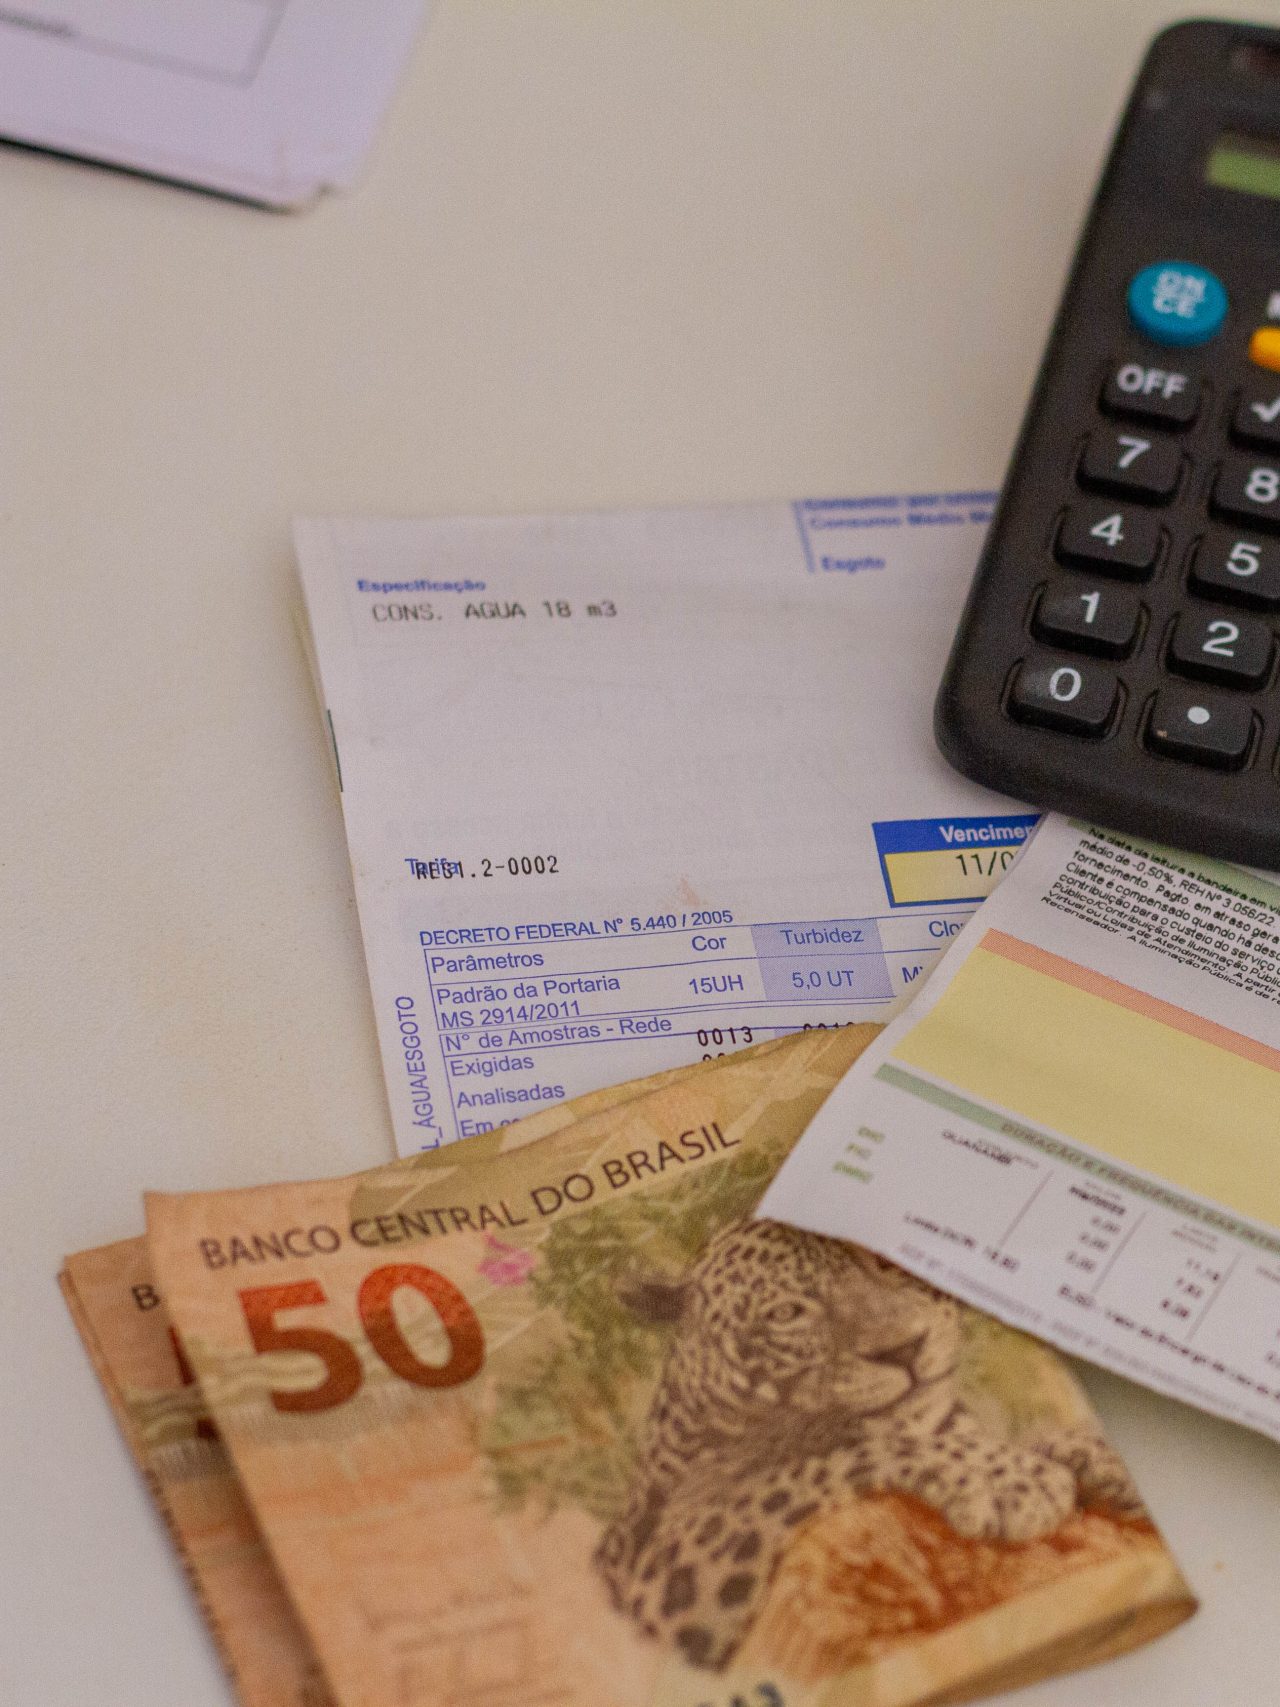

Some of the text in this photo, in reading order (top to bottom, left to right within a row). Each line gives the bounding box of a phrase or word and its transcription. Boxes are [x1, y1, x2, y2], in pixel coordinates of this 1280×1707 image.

[1117, 364, 1187, 400] OFF
[1117, 437, 1151, 469] 7
[1245, 468, 1279, 503] 8
[1091, 514, 1124, 546] 4
[1226, 544, 1260, 577] 5
[357, 579, 486, 594] Especificação
[372, 603, 442, 622] CONS.
[464, 602, 527, 619] AGUA
[543, 600, 572, 618] 18
[1080, 592, 1100, 623] 1
[1202, 622, 1239, 657] 2
[1049, 667, 1082, 702] 0
[1066, 862, 1104, 884] Cliente
[1116, 885, 1190, 920] compensado
[1192, 917, 1235, 940] quando
[420, 927, 511, 947] DECRETO
[515, 921, 600, 940] FEDERAL
[631, 914, 678, 932] 5.440
[691, 910, 733, 927] 2005
[781, 928, 865, 946] Turbidez
[929, 920, 965, 938] Clo
[1058, 874, 1130, 909] contribuição
[1131, 905, 1159, 921] para
[1170, 921, 1212, 944] custeio
[1231, 948, 1275, 971] serviço
[1213, 911, 1250, 931] atraso
[1251, 928, 1279, 944] gera
[691, 935, 728, 951] Cor
[431, 952, 545, 974] Parâmetros
[437, 975, 621, 1006] Padrão da Portaria
[689, 975, 744, 994] 15UH
[792, 970, 854, 990] 5,0 UT
[441, 1000, 582, 1029] MS 2914/2011
[478, 1033, 503, 1049] de
[508, 1023, 601, 1046] Amostras
[619, 1017, 673, 1036] Rede
[697, 1026, 753, 1047] 0013
[450, 1055, 535, 1078] Exigidas
[457, 1083, 566, 1109] Analisadas
[199, 1119, 743, 1272] BANCO CENTRAL DO BRASIL
[237, 1261, 487, 1416] 50
